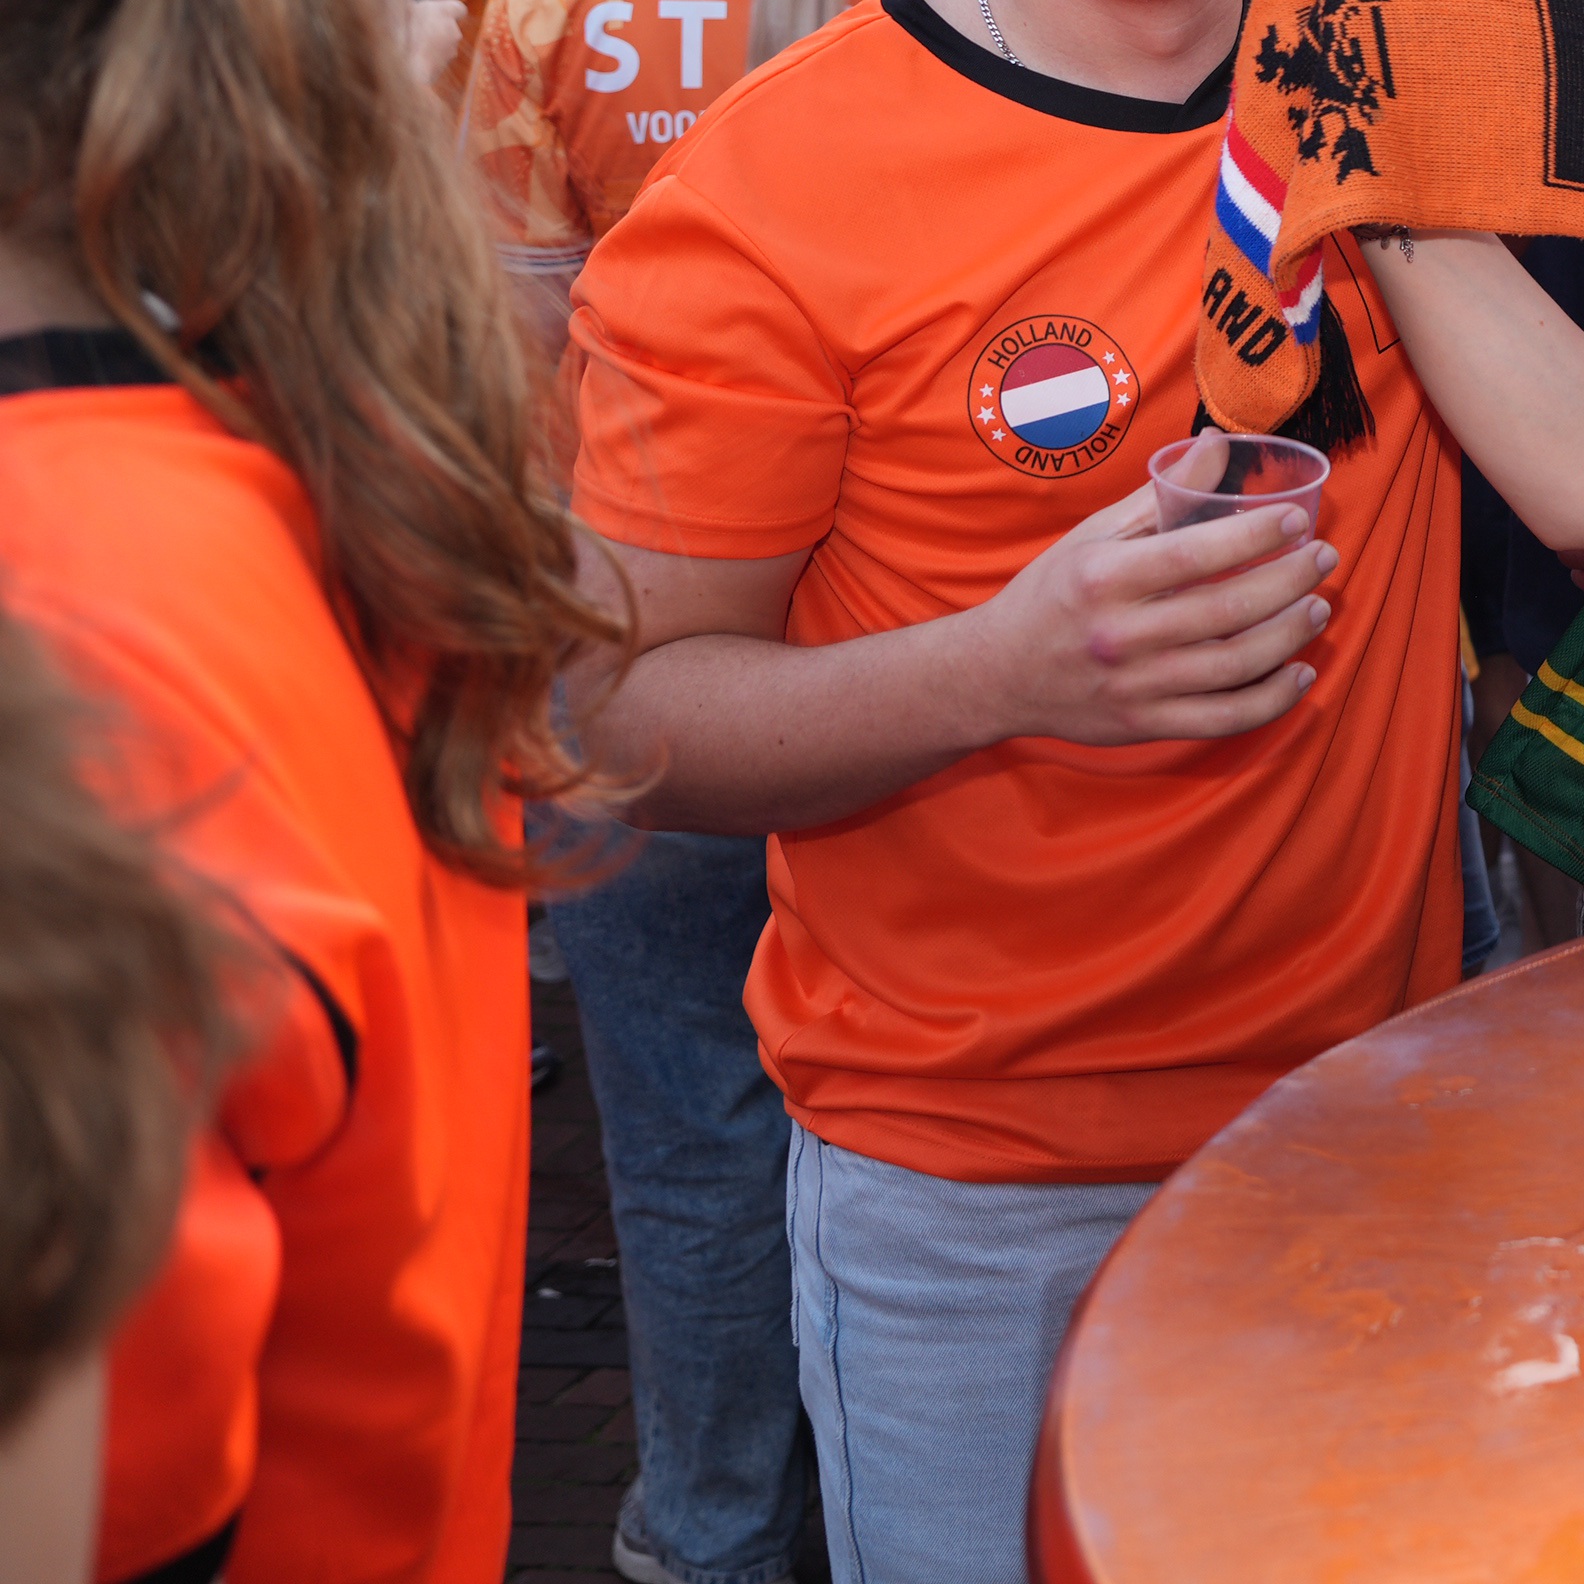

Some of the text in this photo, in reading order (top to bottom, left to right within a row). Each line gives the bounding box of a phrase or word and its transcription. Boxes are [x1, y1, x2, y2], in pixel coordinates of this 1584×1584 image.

[625, 109, 707, 145] VOO
[1202, 254, 1289, 368] AND
[987, 321, 1092, 370] HOLLAND
[1014, 422, 1121, 472] HOLLAND
